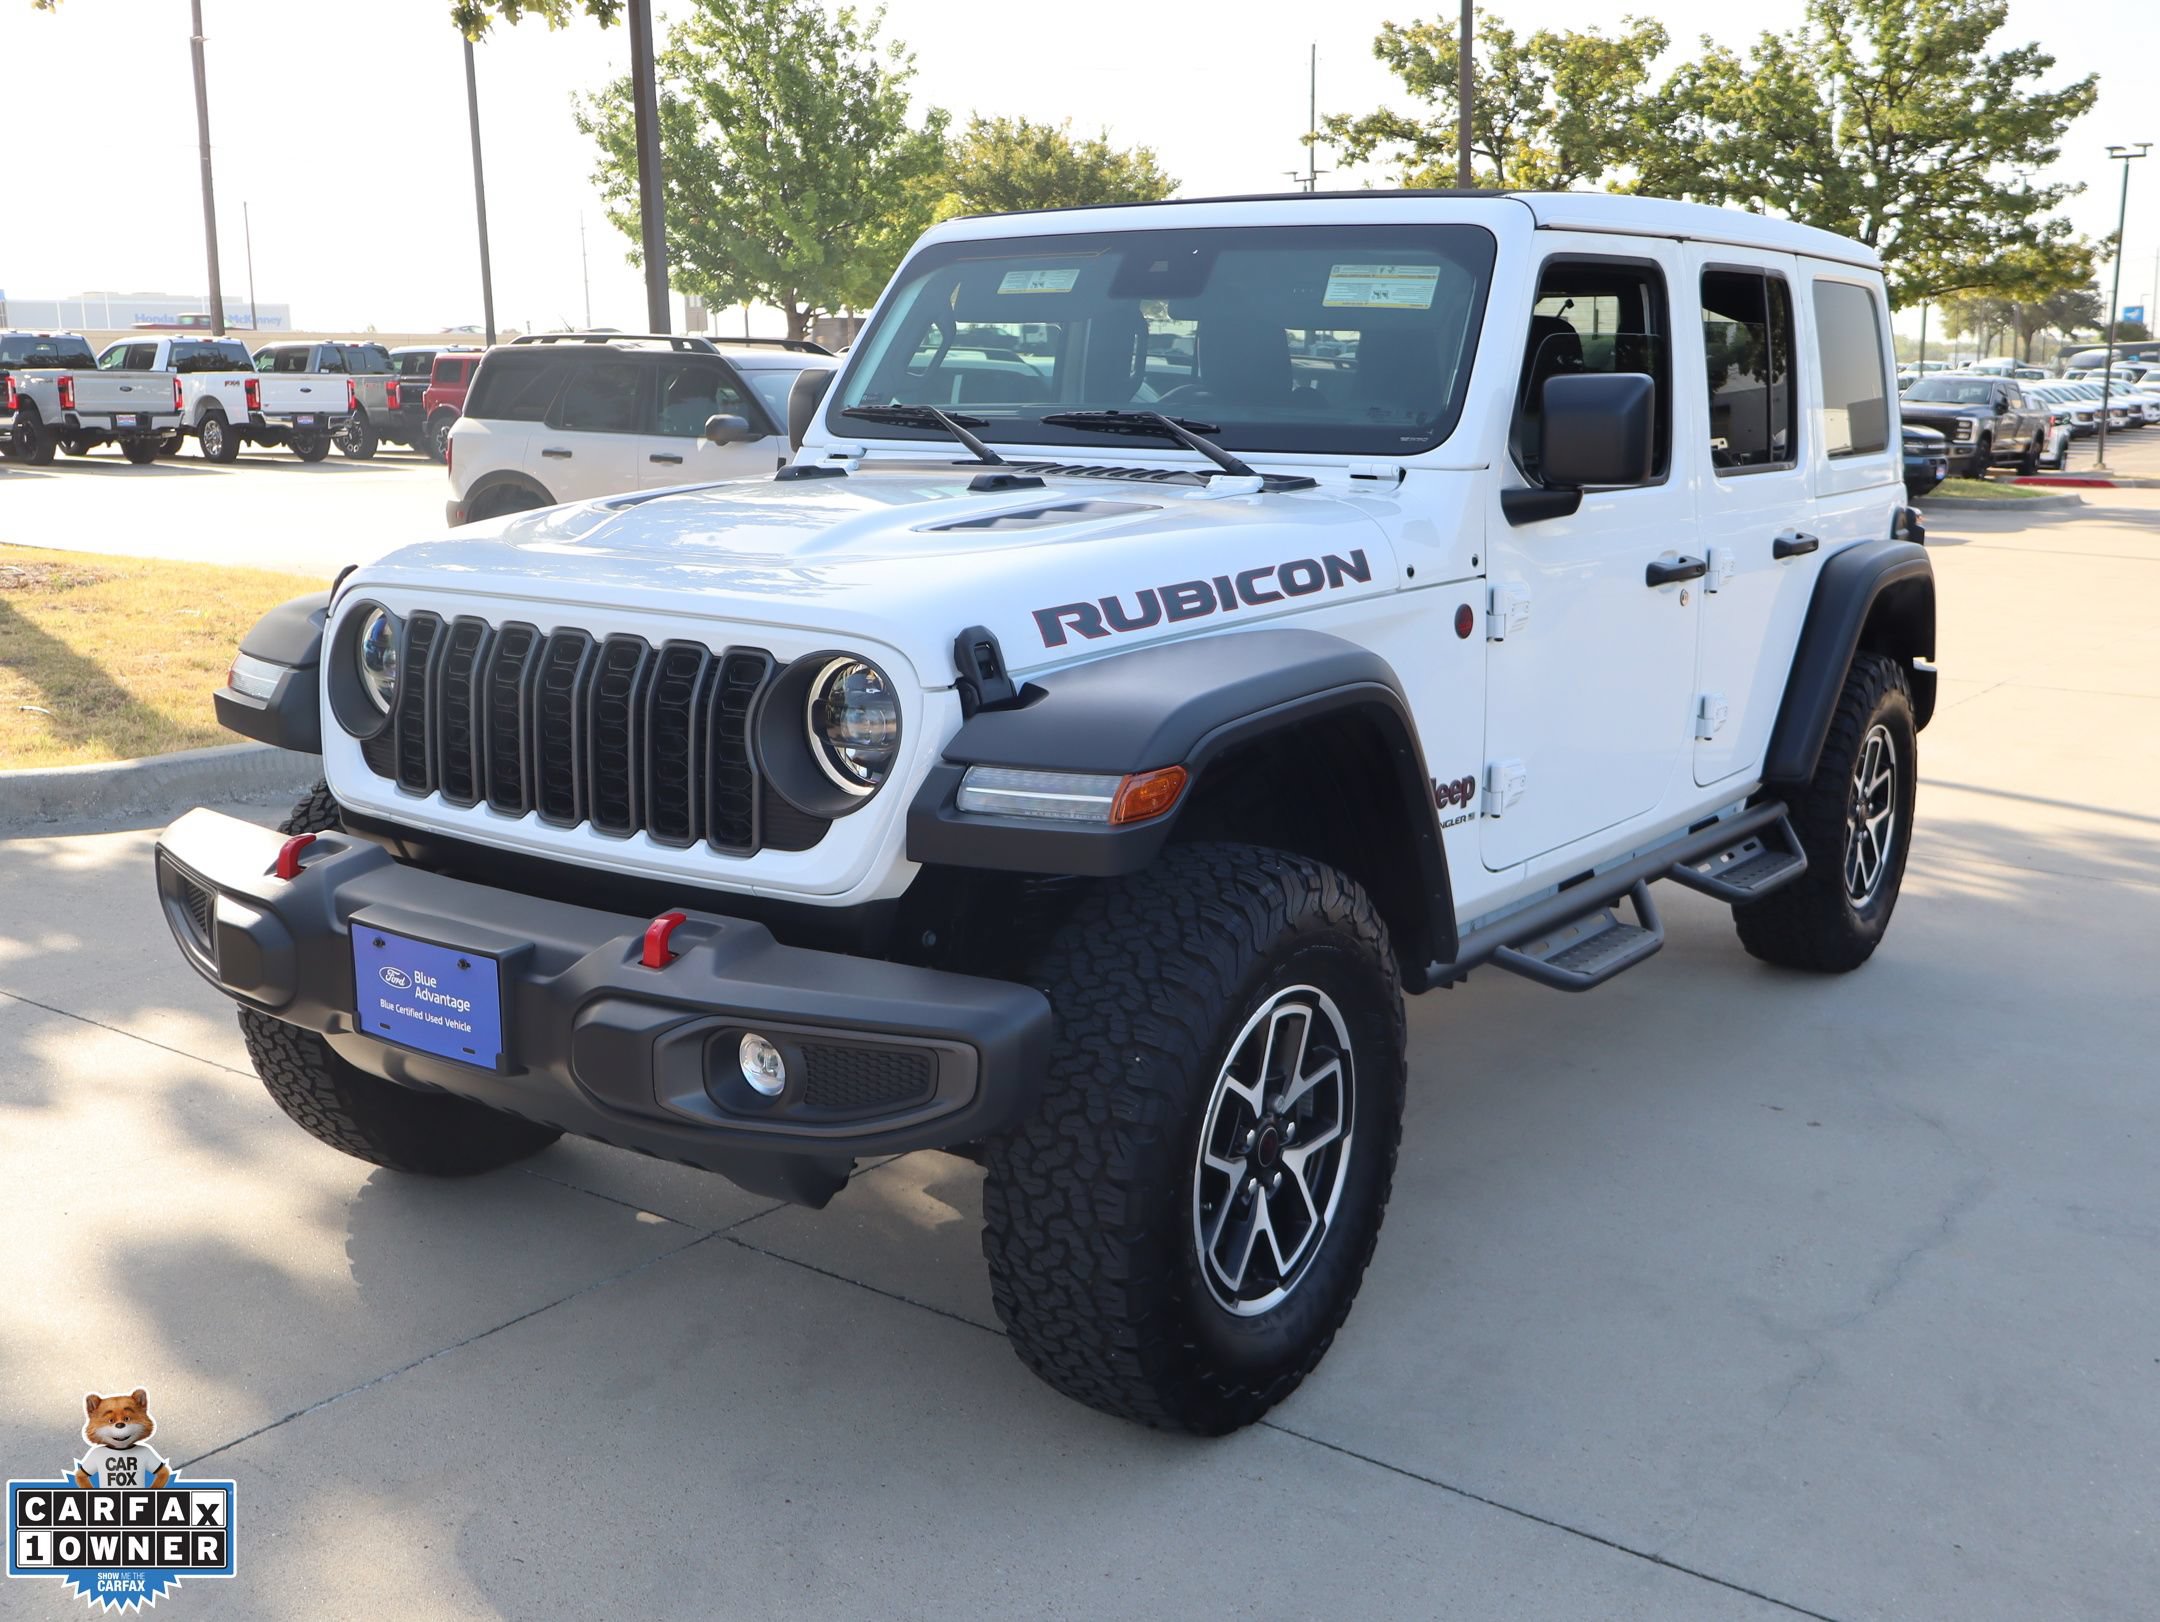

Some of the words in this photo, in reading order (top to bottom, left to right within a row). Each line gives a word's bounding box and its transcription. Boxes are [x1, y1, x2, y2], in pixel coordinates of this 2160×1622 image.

[134, 313, 175, 323] Honda
[228, 314, 282, 326] McKnney
[1031, 548, 1372, 648] RUBICON
[1430, 775, 1475, 810] eep
[414, 970, 437, 988] Blue
[415, 987, 471, 1012] Advantage
[380, 998, 395, 1011] Blue
[395, 1004, 424, 1020] Certified
[424, 1013, 443, 1025] Used
[445, 1017, 472, 1033] Vehicle
